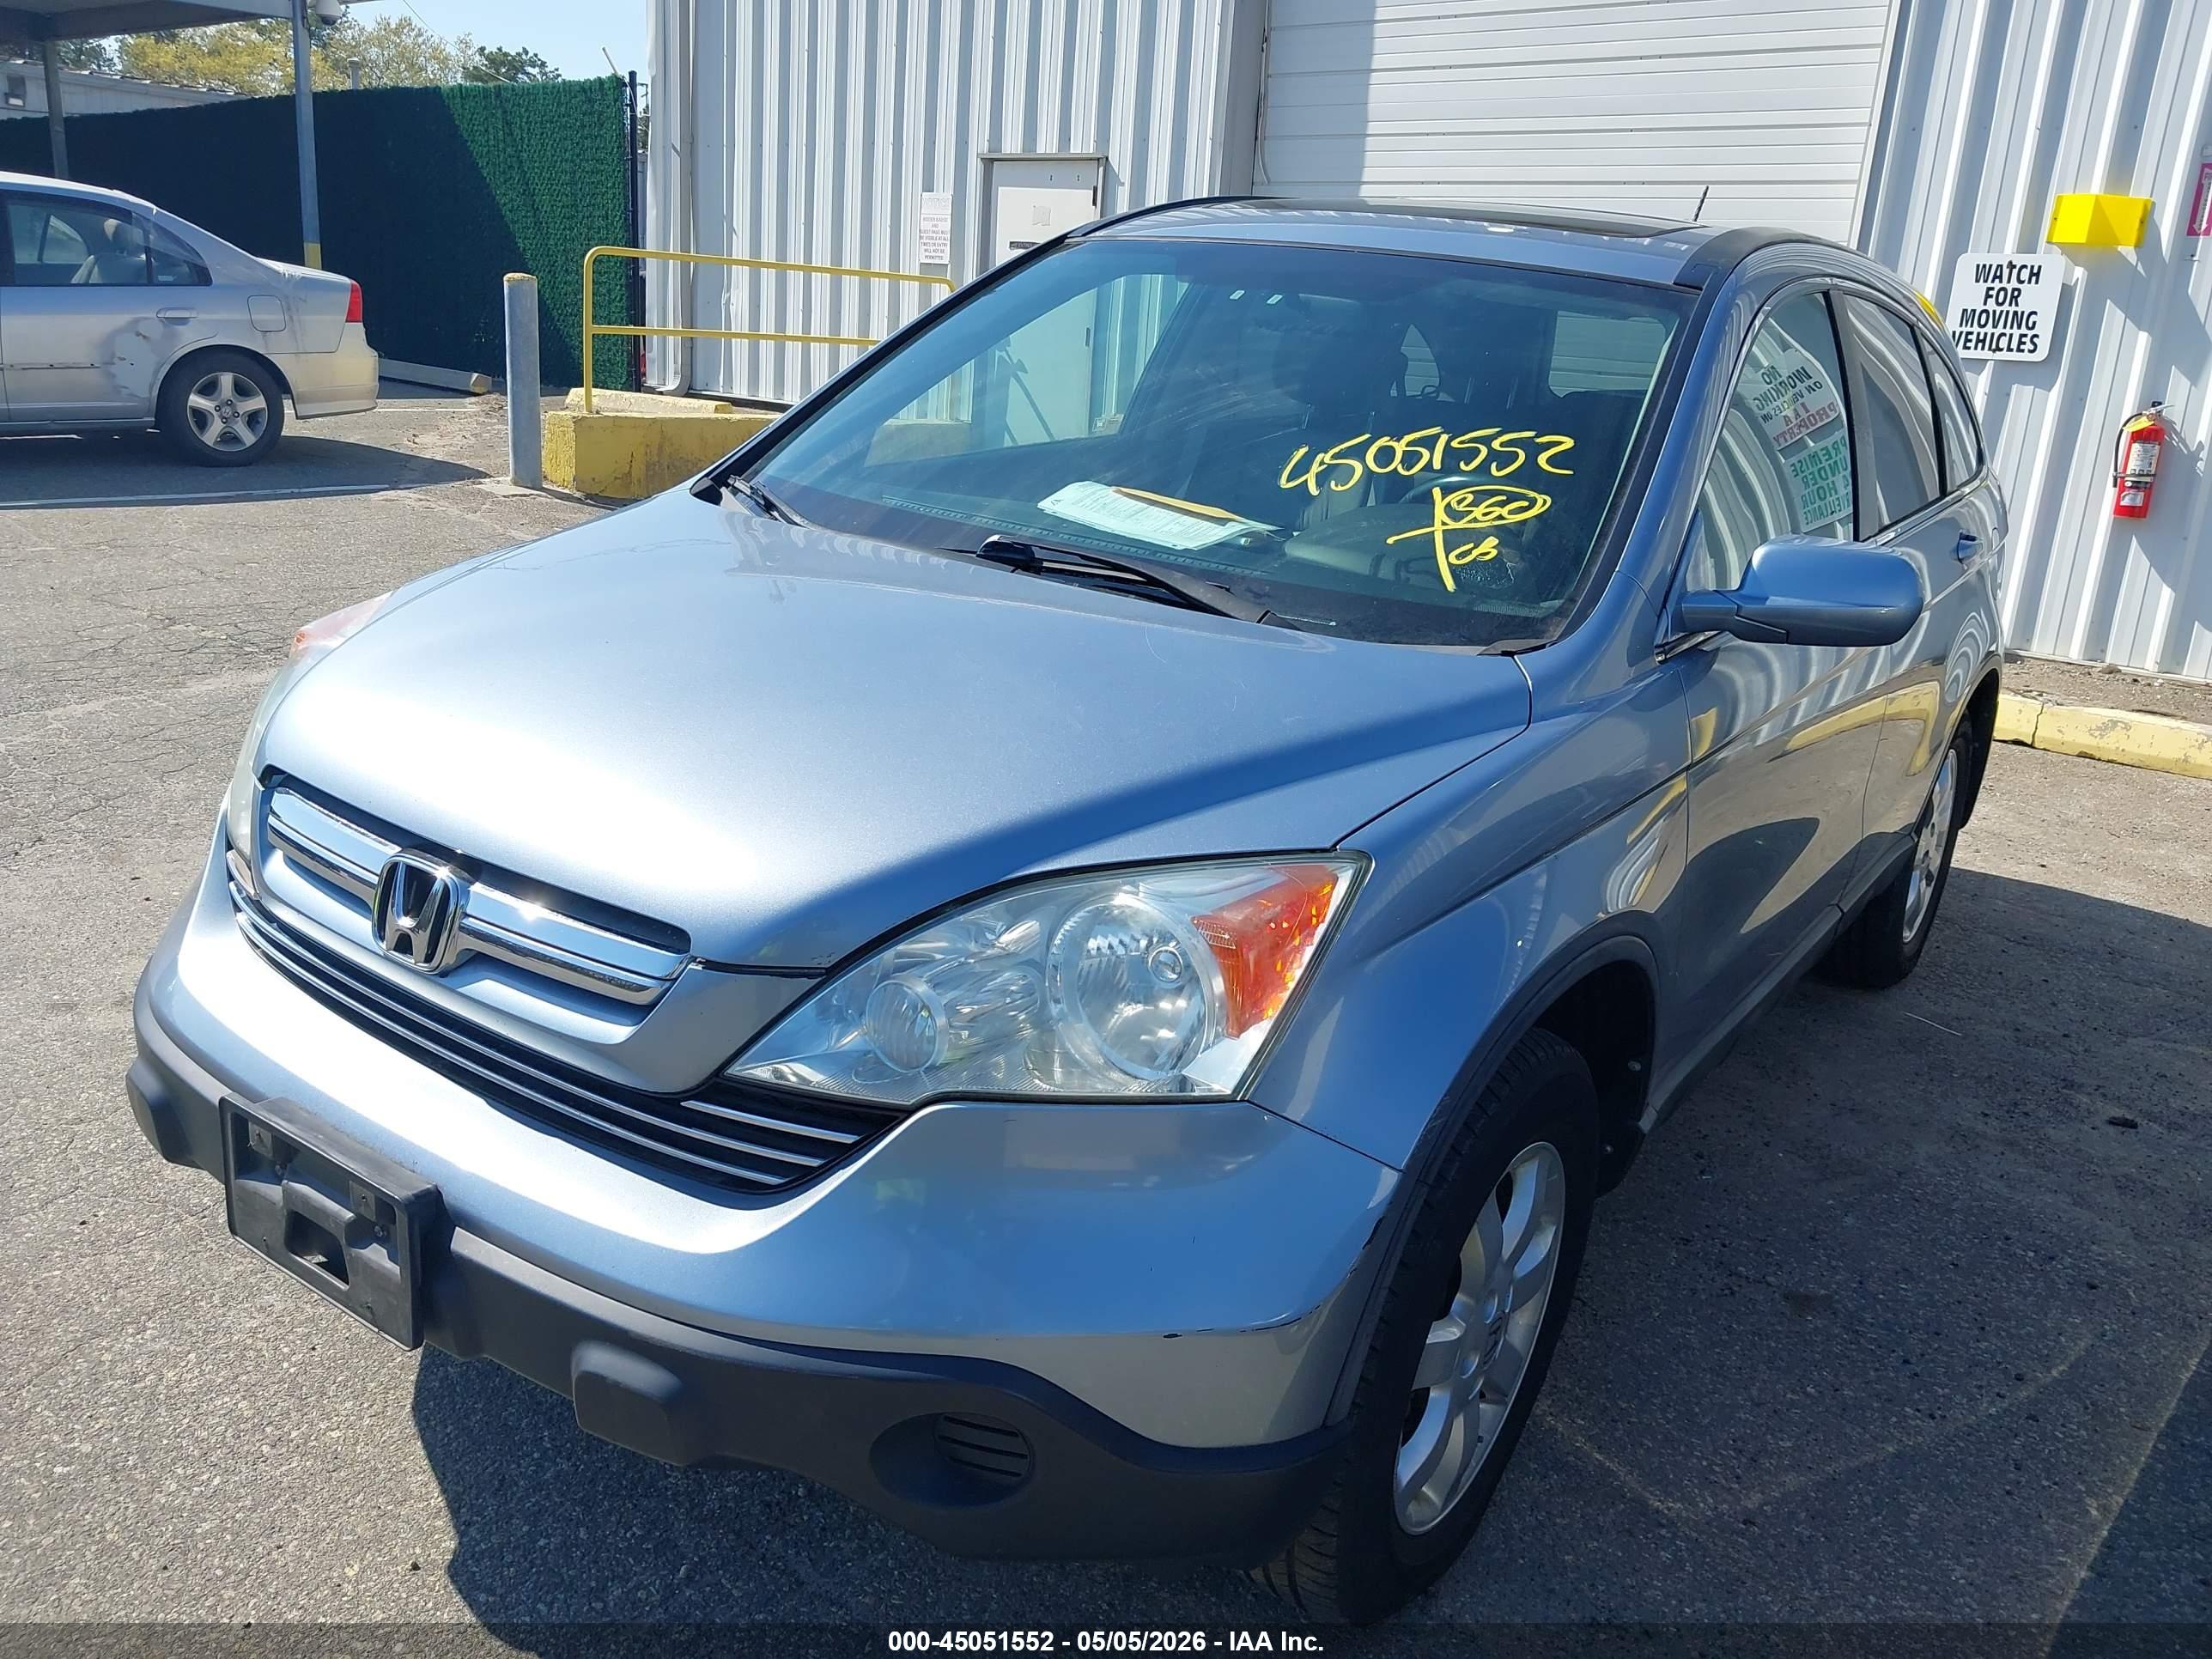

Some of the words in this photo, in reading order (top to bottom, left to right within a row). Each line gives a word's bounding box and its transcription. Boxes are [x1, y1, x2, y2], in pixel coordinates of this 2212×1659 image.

[1975, 263, 2042, 284] WATCH
[1983, 287, 2022, 307] FOR
[1959, 308, 2039, 331] MOVING
[1951, 331, 2039, 354] VEHICLES
[1279, 426, 1575, 496] 45051552
